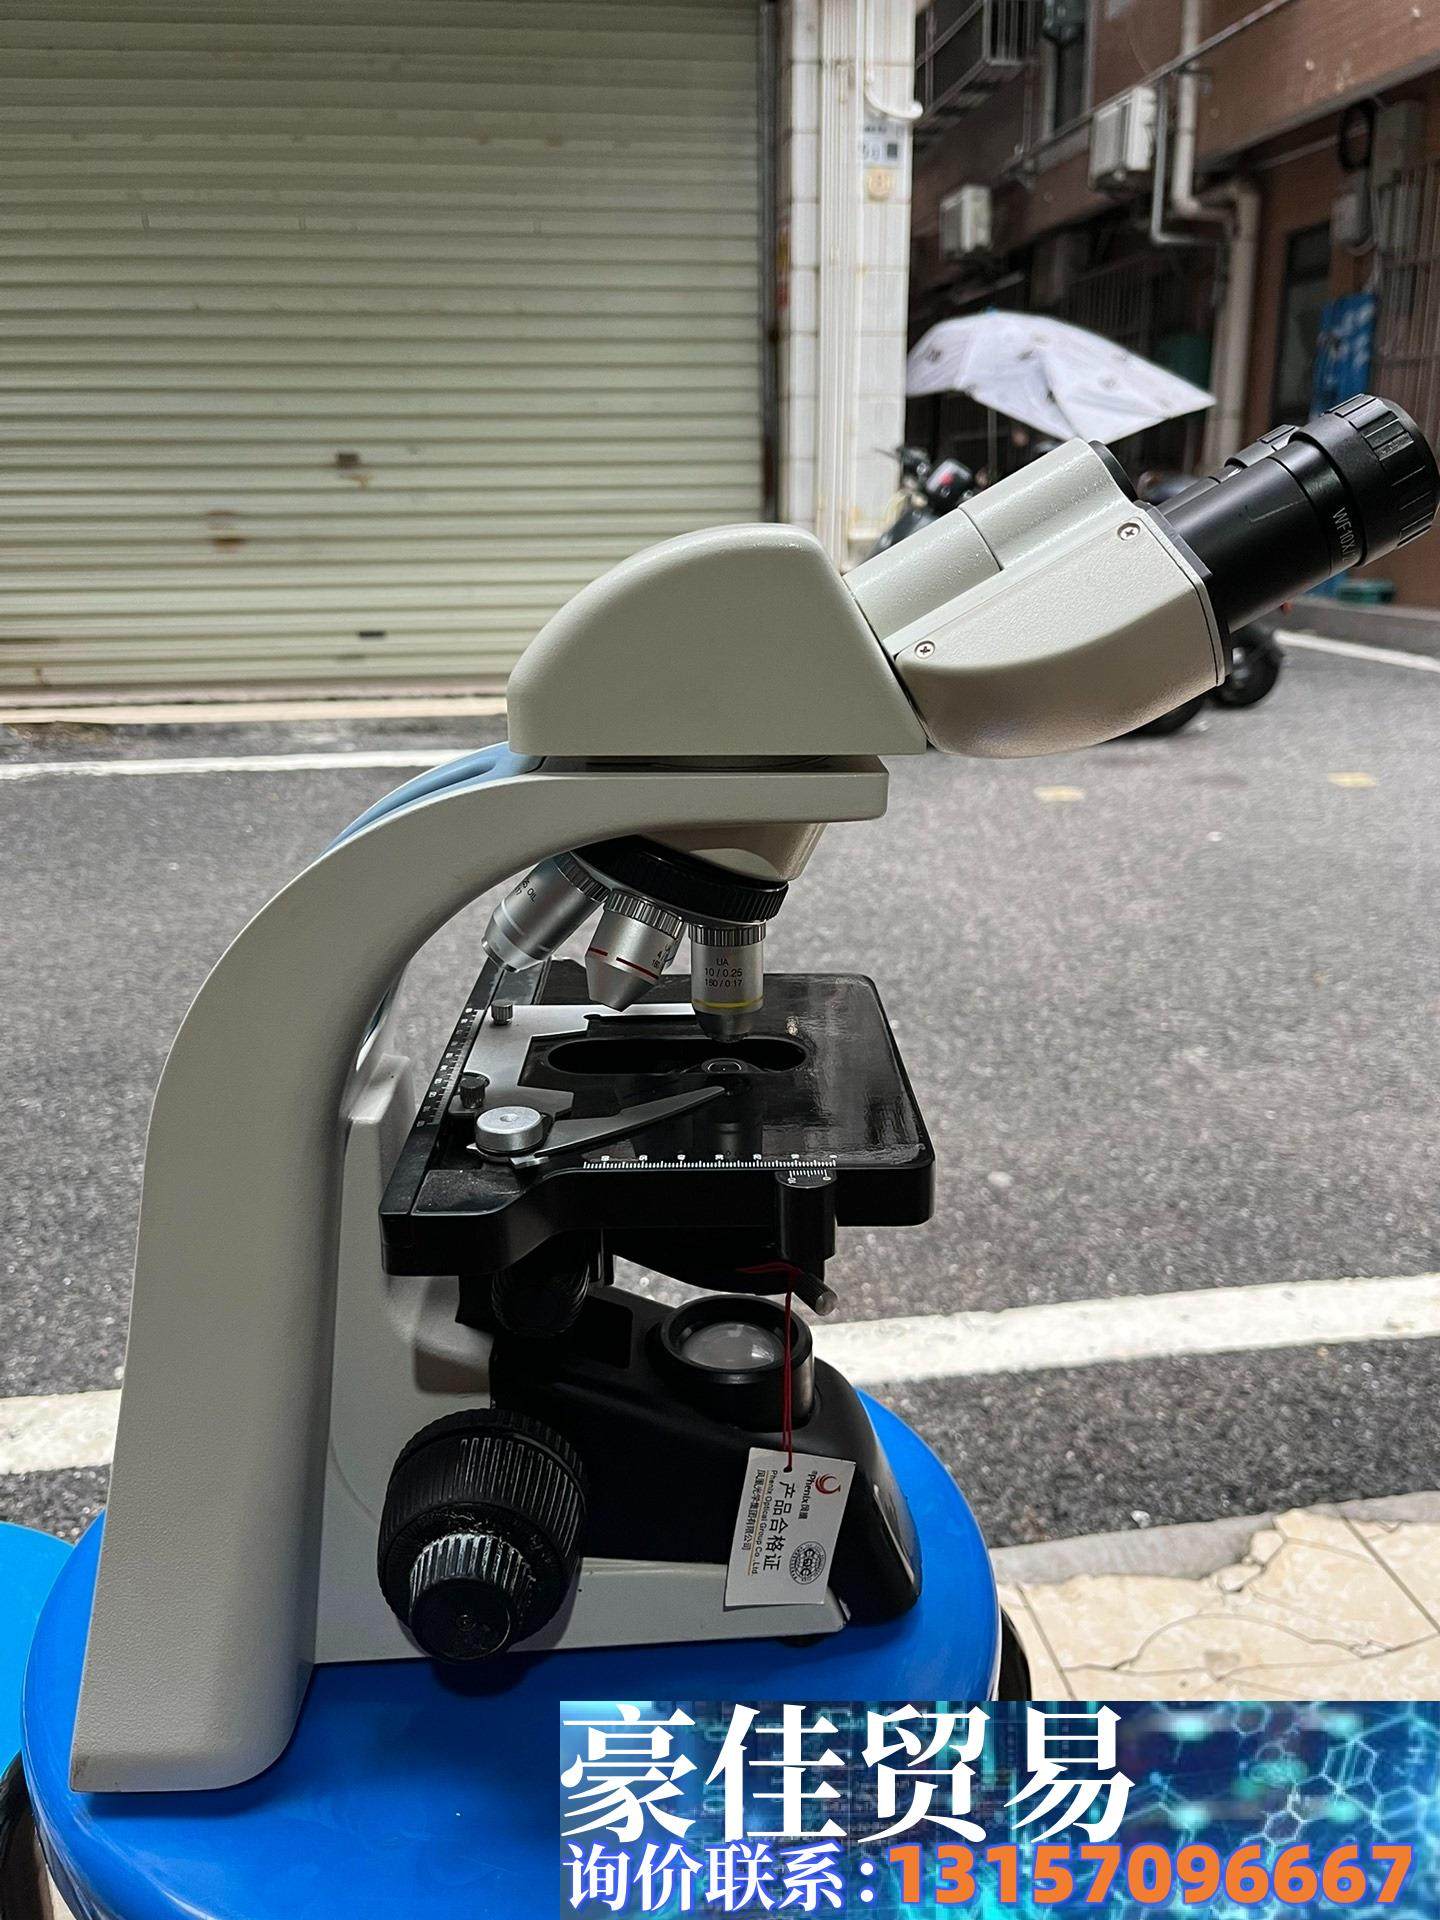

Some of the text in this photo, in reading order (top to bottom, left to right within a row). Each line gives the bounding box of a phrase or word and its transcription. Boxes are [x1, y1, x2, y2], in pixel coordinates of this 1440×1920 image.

[527, 887, 537, 904] OIL
[716, 957, 729, 967] UA
[767, 1469, 778, 1495] Phenix
[741, 1469, 766, 1551] 凤凰光学集团有限公司
[761, 1495, 773, 1521] Optical
[755, 1522, 767, 1546] Group
[762, 1481, 796, 1571] 产品合格证
[800, 1547, 816, 1578] CQC
